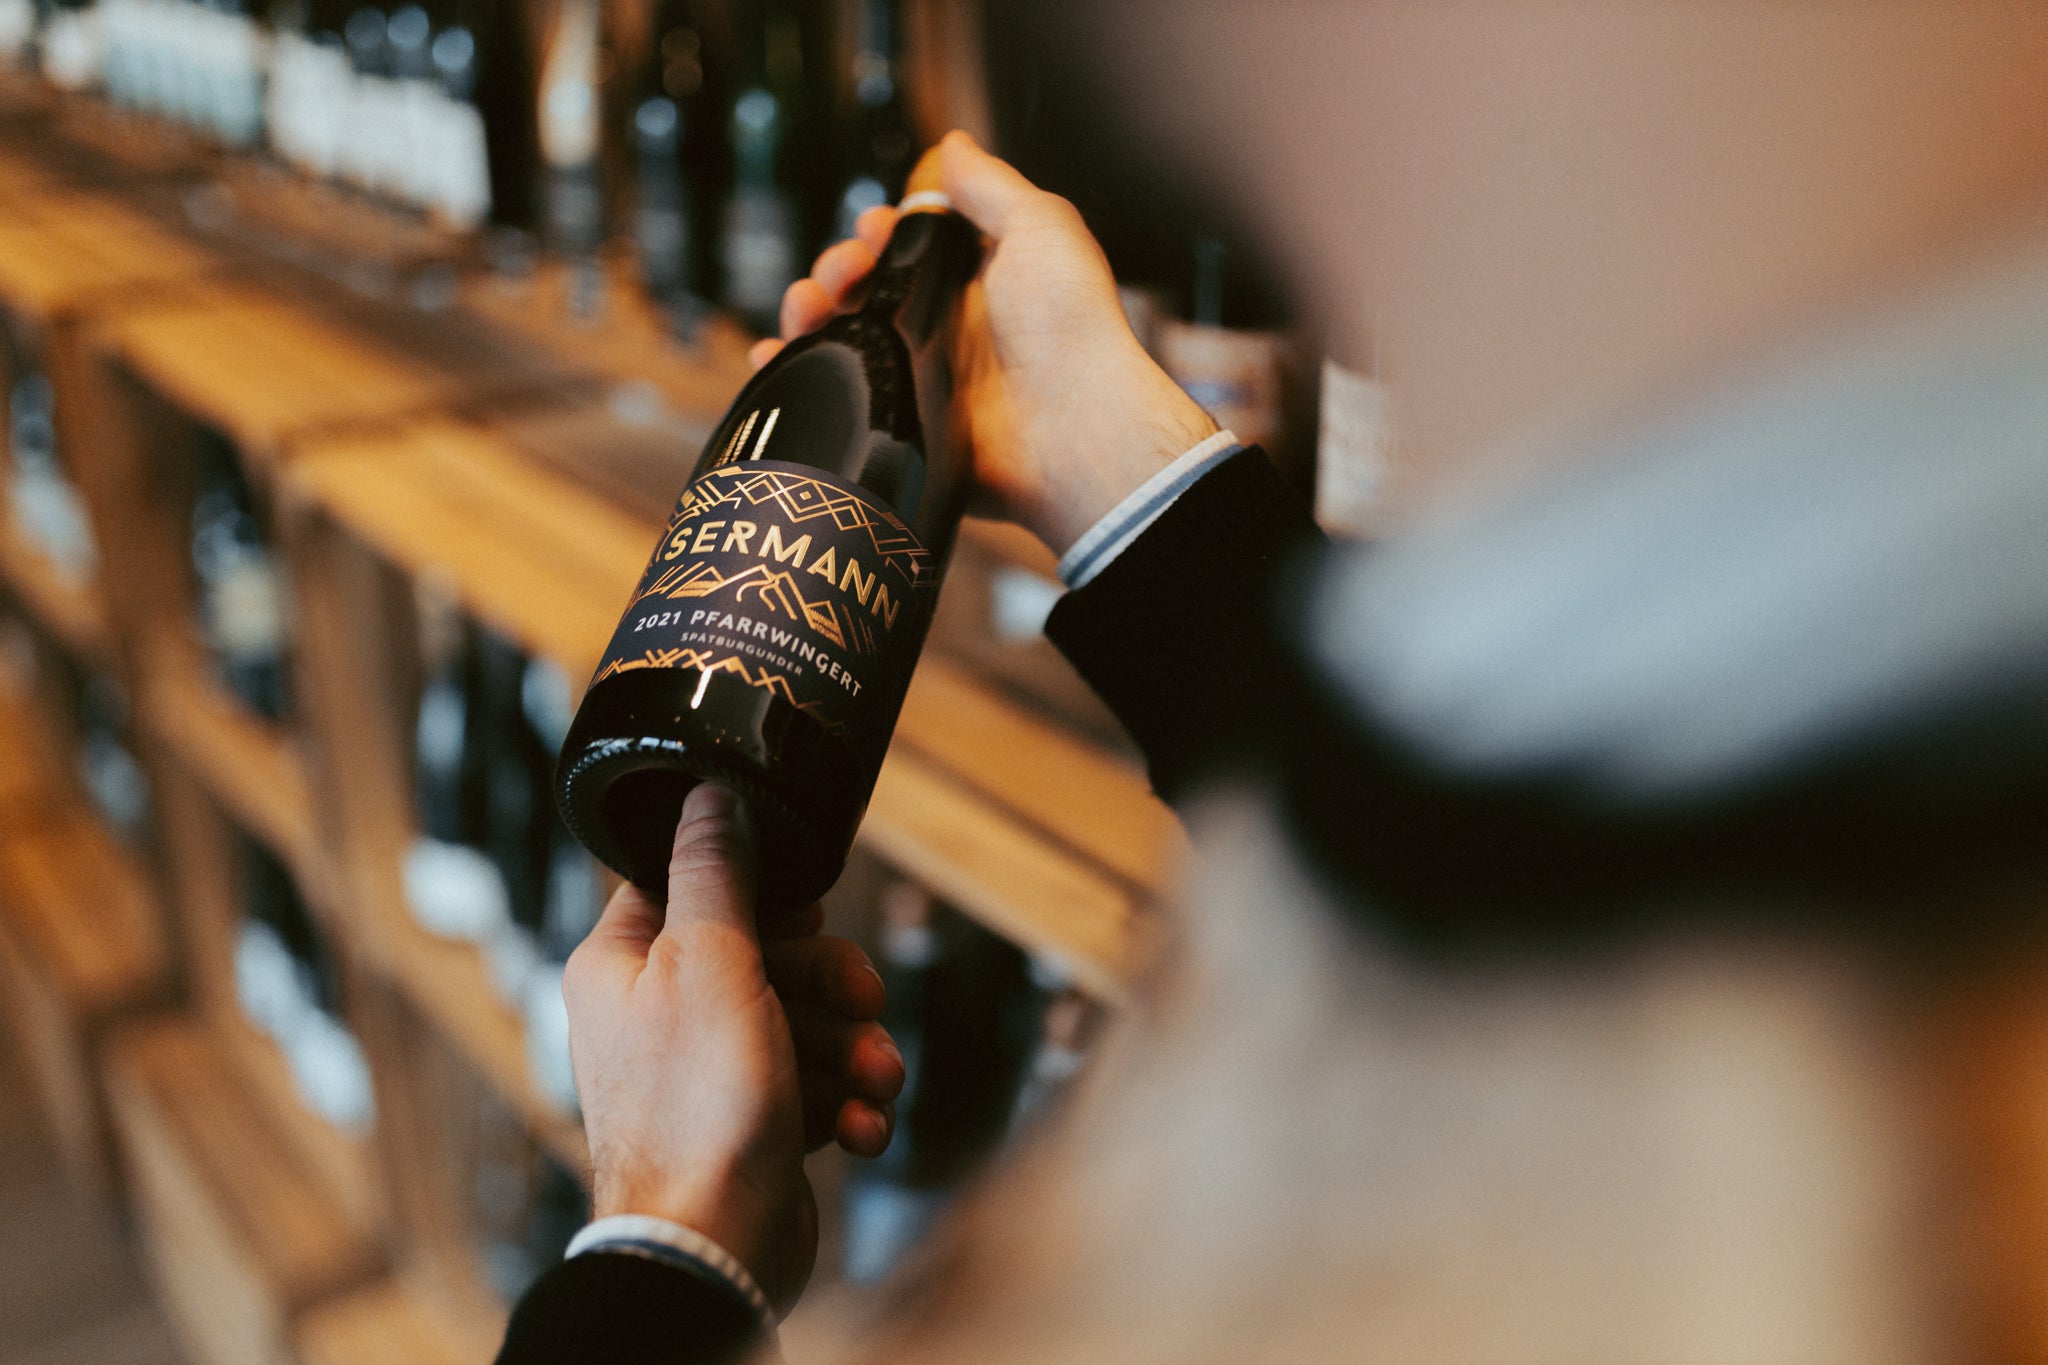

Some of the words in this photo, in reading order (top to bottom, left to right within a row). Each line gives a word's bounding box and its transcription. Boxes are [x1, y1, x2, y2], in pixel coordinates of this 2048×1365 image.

[664, 520, 899, 630] SERMANN
[634, 610, 682, 632] 2021
[690, 609, 862, 697] PFARRWINGERT
